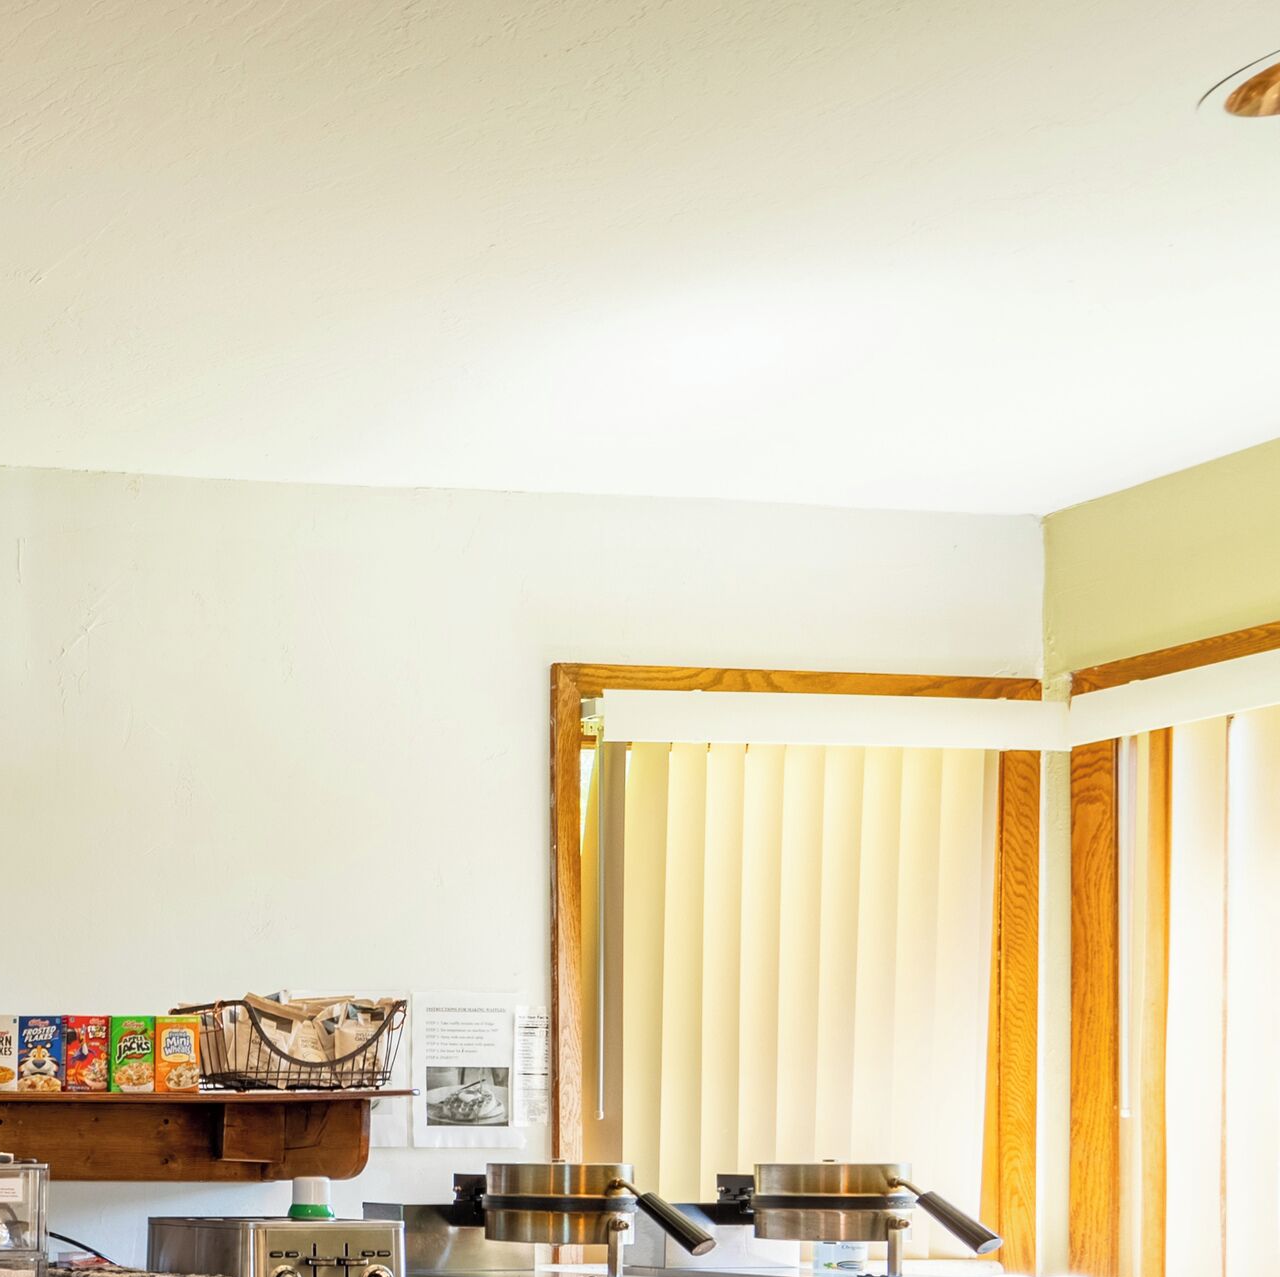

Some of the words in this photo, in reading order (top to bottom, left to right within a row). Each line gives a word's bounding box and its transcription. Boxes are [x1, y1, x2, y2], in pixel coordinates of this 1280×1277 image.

[22, 1025, 58, 1038] FROSTED
[24, 1032, 54, 1044] FLAKES
[165, 1037, 190, 1048] Mini
[115, 1039, 152, 1063] JACKS
